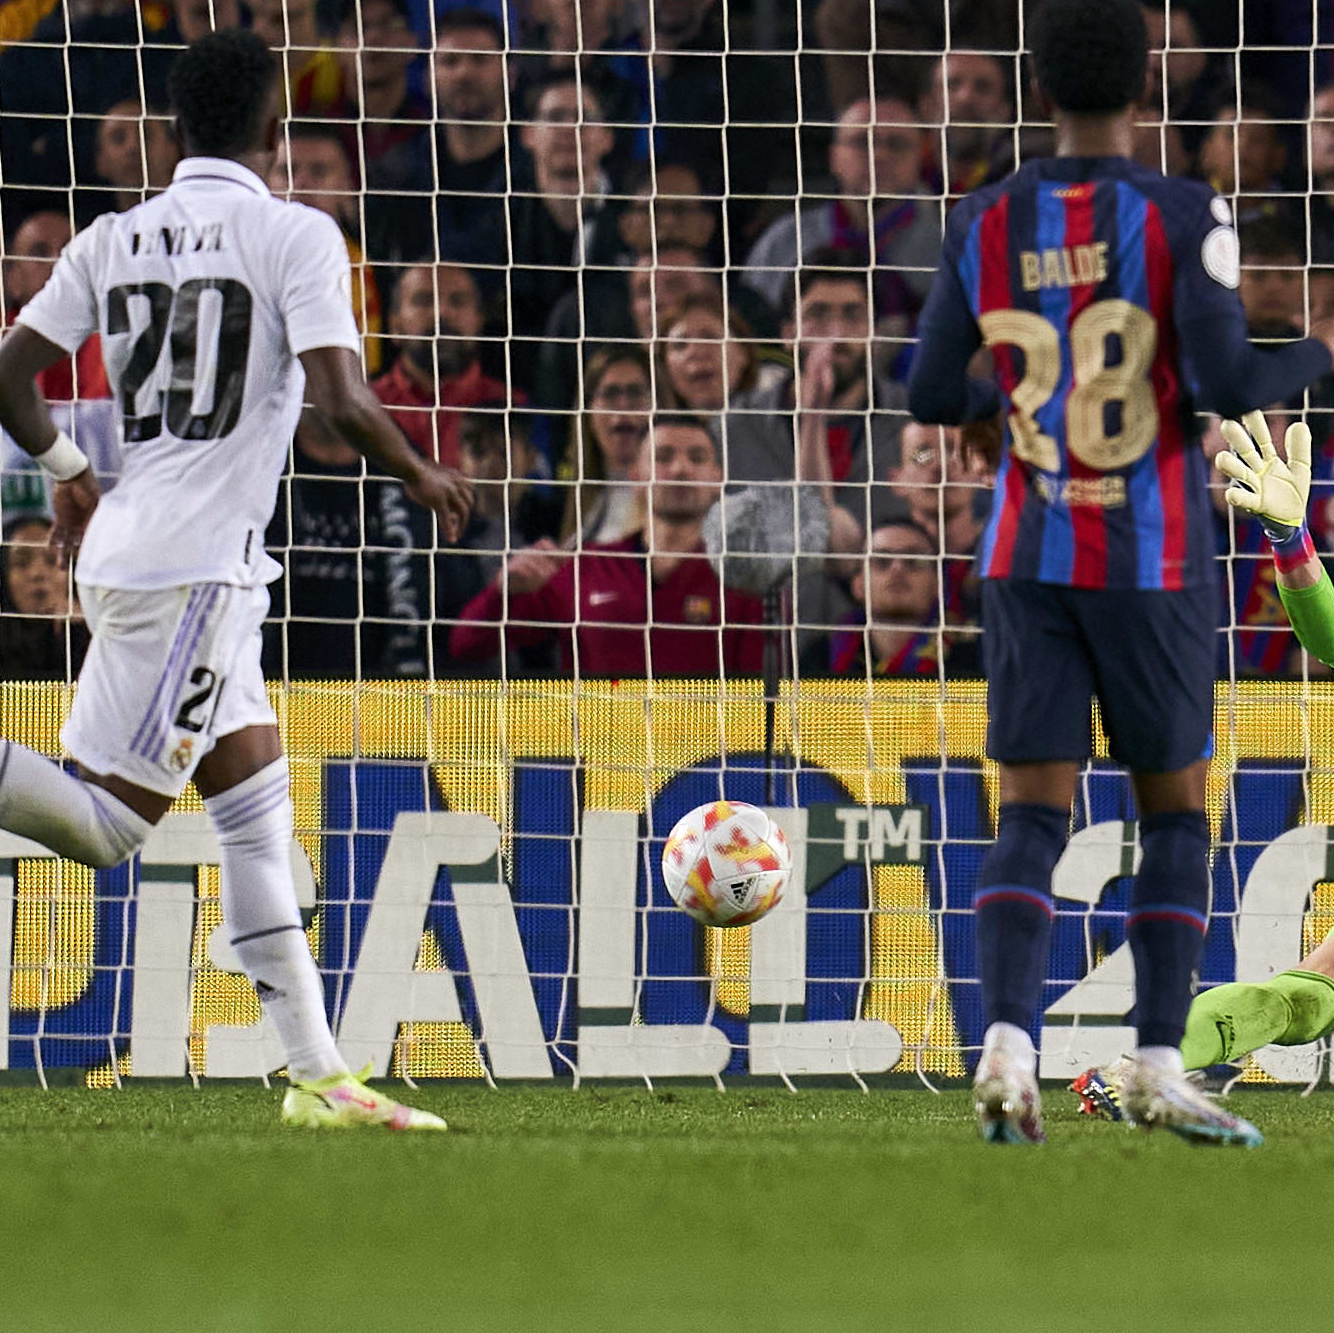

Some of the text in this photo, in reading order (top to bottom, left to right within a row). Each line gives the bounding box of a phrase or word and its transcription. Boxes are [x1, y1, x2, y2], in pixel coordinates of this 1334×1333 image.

[1020, 241, 1108, 291] BALDE
[107, 277, 253, 443] 20
[979, 299, 1158, 472] 28
